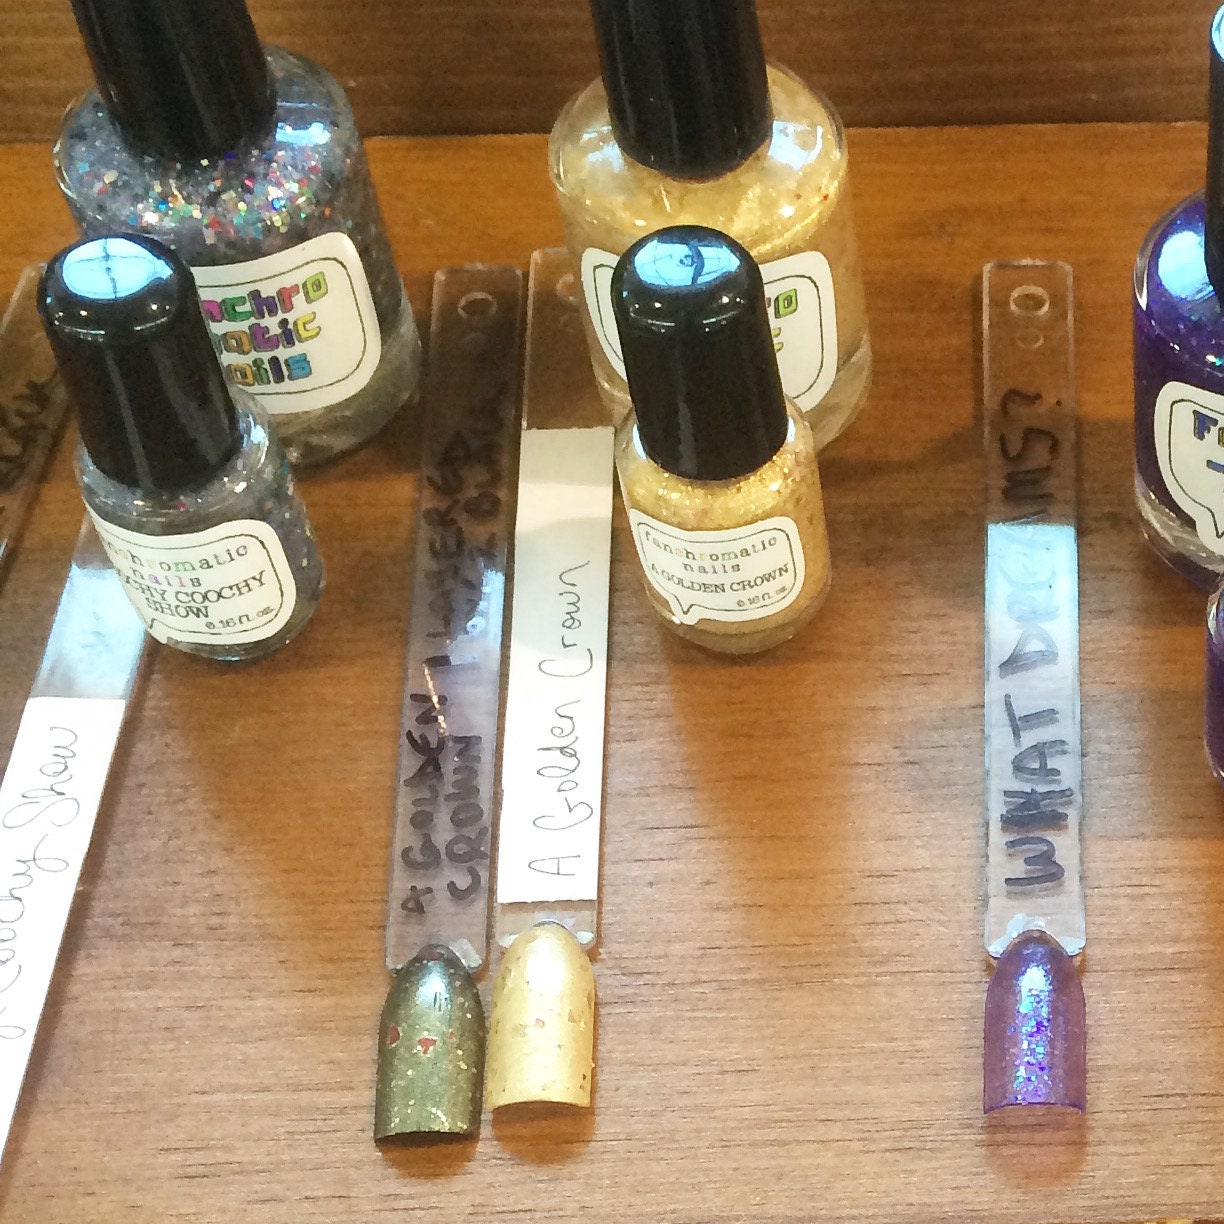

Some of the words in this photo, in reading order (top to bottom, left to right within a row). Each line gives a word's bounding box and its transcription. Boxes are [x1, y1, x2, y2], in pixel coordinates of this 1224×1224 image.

[200, 271, 328, 323] nchro
[213, 311, 321, 356] atic
[224, 352, 312, 387] ails
[129, 566, 202, 588] nails
[174, 569, 267, 605] COOCHY
[660, 568, 726, 594] GOLDEN
[729, 562, 790, 592] CROWN
[682, 561, 741, 574] nails
[145, 596, 210, 619] SHOW
[538, 560, 593, 677] Crown
[2, 726, 80, 830] Show
[401, 693, 448, 871] GOLDEN
[532, 699, 594, 831] Golden
[1000, 693, 1074, 888] WHAT
[443, 735, 489, 900] CROWN
[527, 854, 581, 876] A
[400, 885, 434, 914] A
